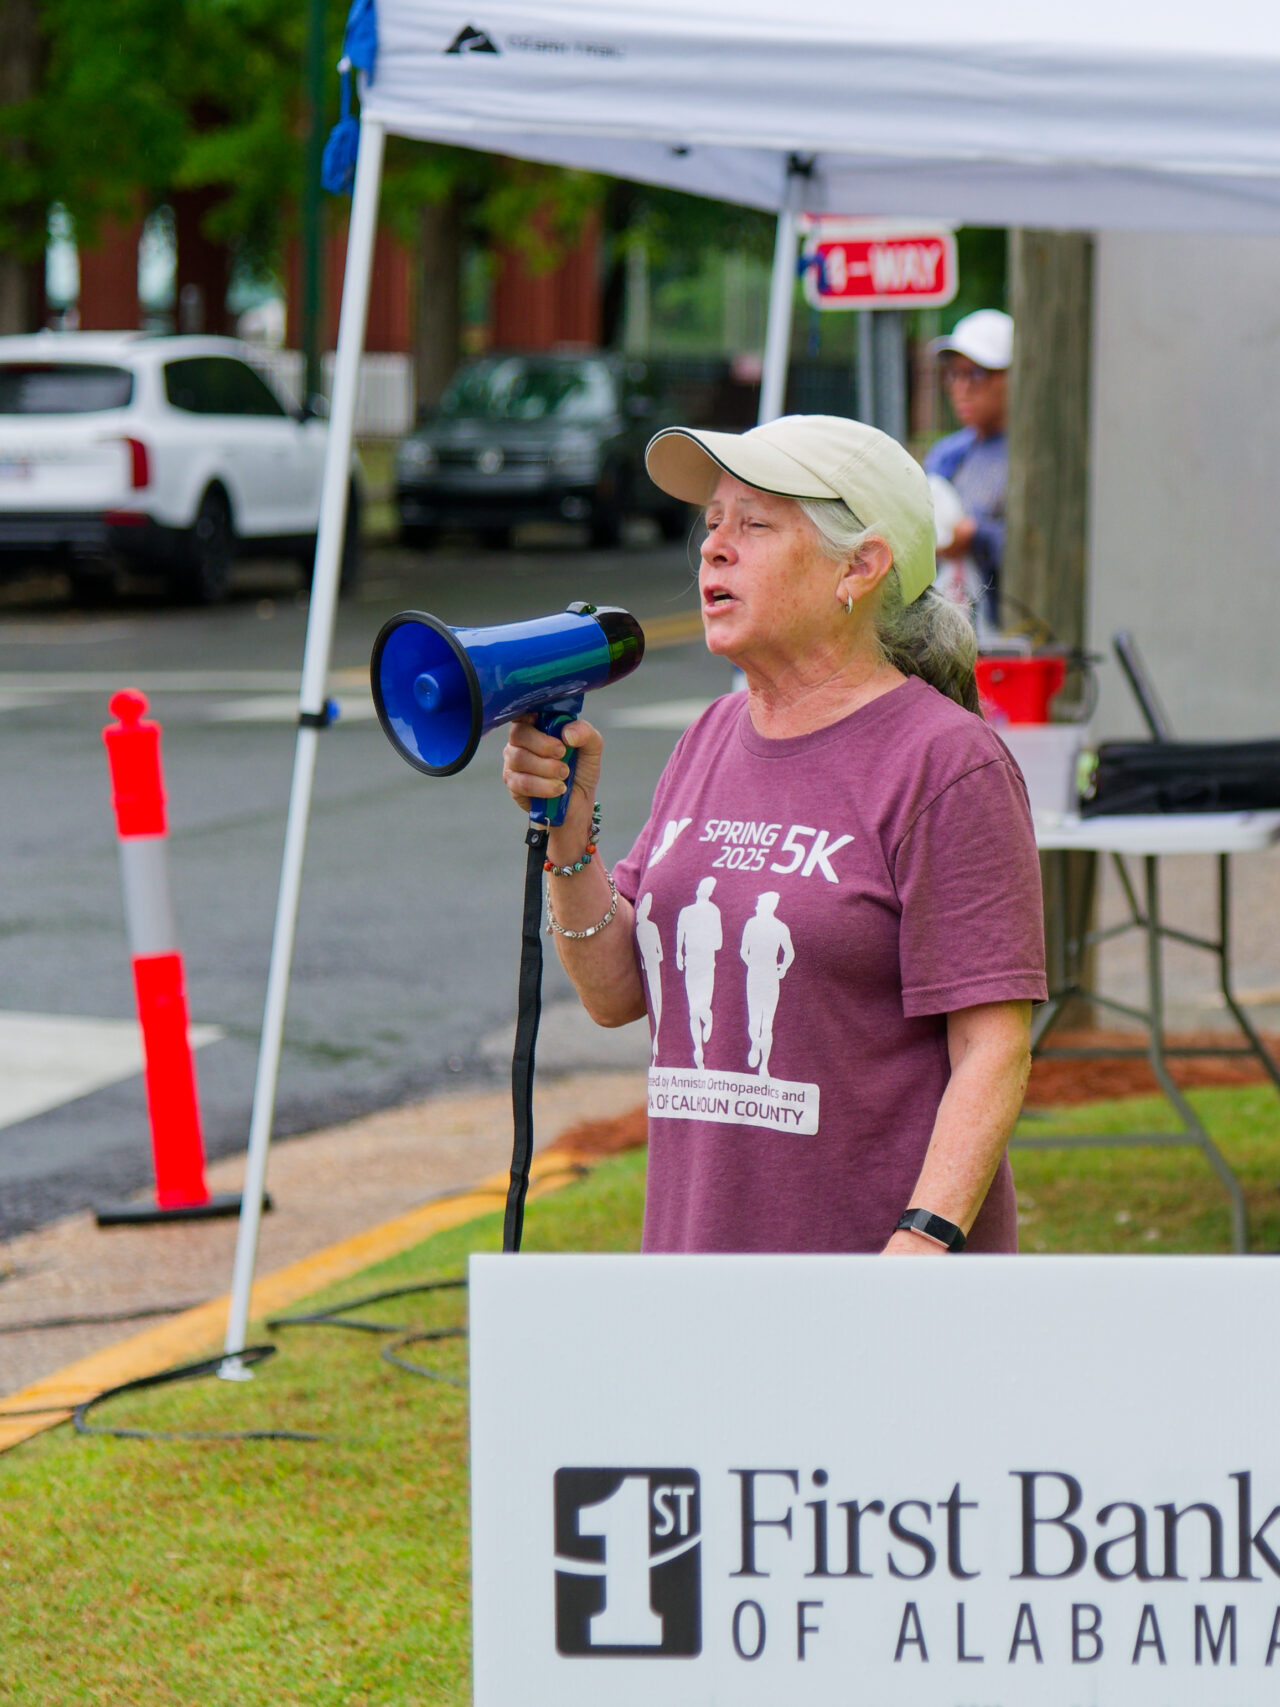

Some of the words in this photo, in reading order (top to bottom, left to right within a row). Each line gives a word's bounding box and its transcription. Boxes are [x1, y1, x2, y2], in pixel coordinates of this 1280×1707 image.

[699, 818, 783, 846] SPRING
[711, 845, 770, 871] 2025
[769, 824, 856, 884] 5K
[708, 1077, 780, 1099] Orthopaedics
[781, 1090, 806, 1103] and
[657, 1093, 669, 1110] OF
[671, 1095, 729, 1115] CALHOUN
[734, 1100, 804, 1126] COUNTY
[727, 1468, 981, 1582] First
[731, 1599, 824, 1662] OF
